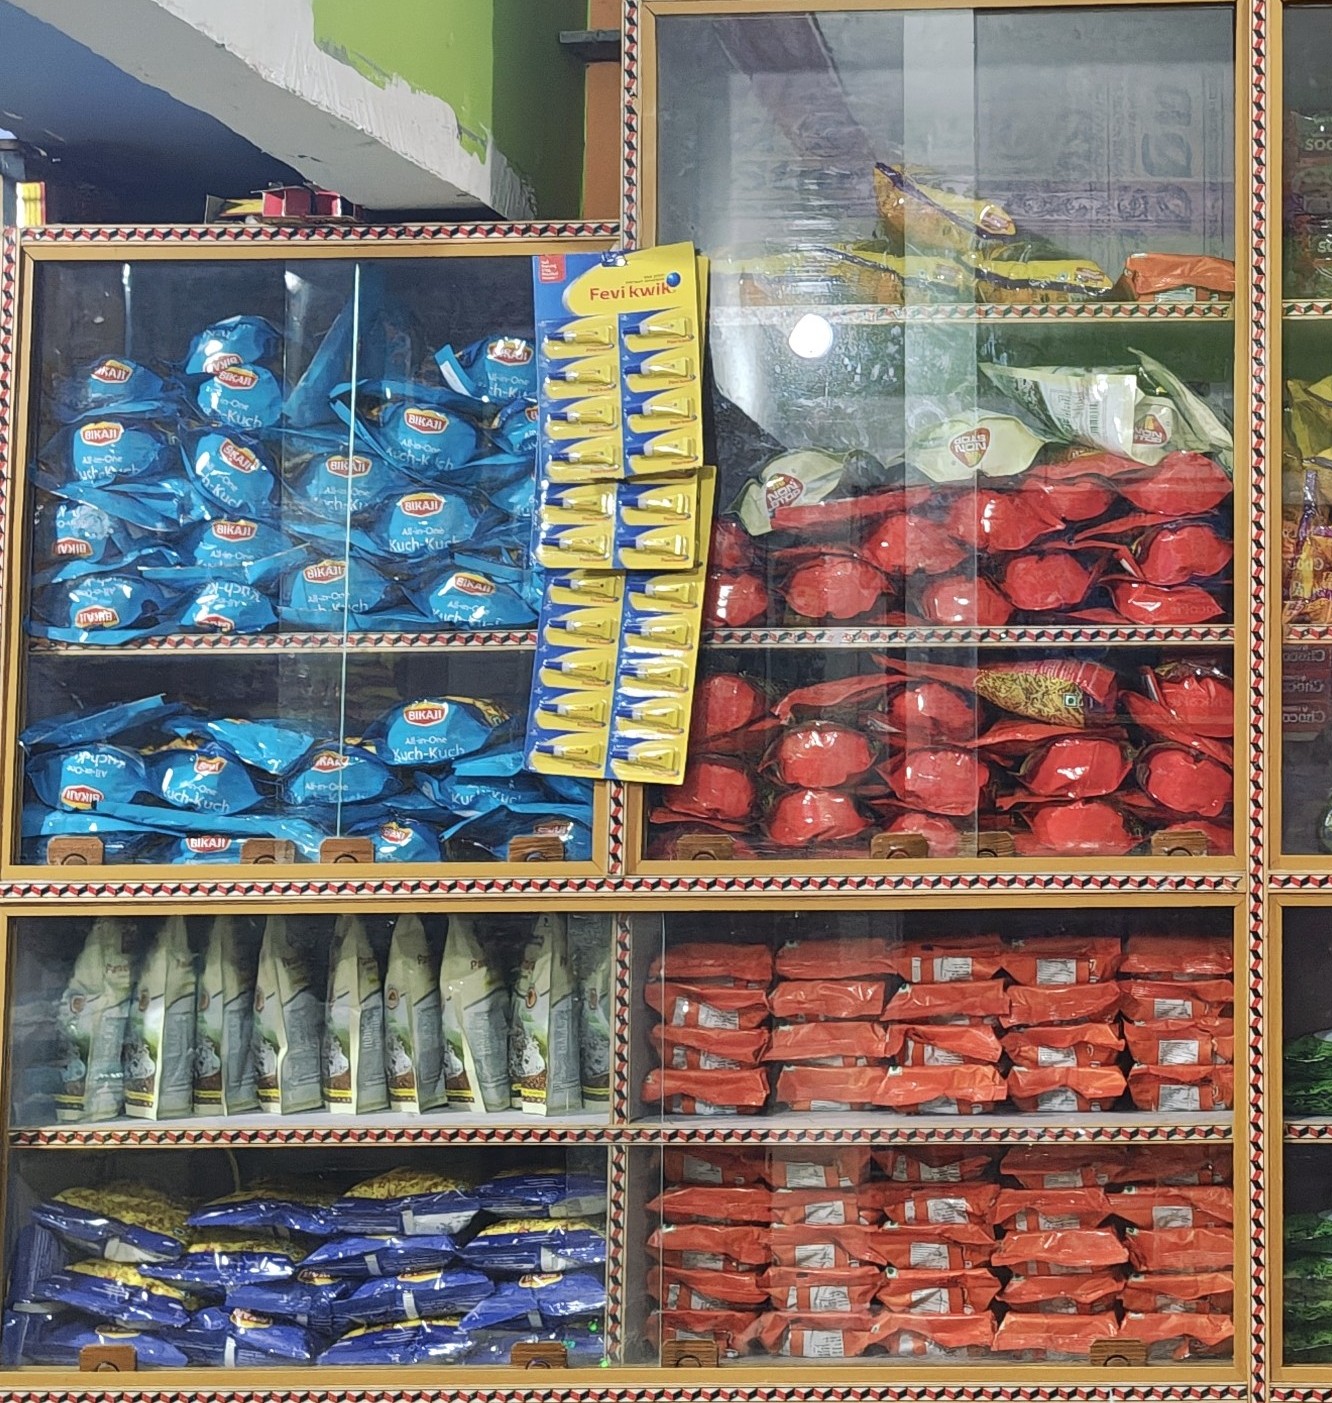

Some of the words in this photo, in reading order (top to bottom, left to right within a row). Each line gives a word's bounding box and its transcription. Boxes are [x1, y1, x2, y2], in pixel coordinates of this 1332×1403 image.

[590, 285, 625, 301] Fevi
[629, 282, 671, 298] kwik
[219, 371, 253, 387] BIKAJI
[408, 414, 443, 431] BIKAJI
[85, 429, 117, 441] BIKAJI
[955, 442, 986, 453] NON
[405, 500, 440, 512] BIKAJI
[216, 524, 251, 536] BIKAJI
[307, 568, 342, 580] BIKAJI
[455, 576, 492, 593] BIKAJI
[409, 708, 442, 721] BIKAJI
[190, 837, 226, 849] BIKAJI
